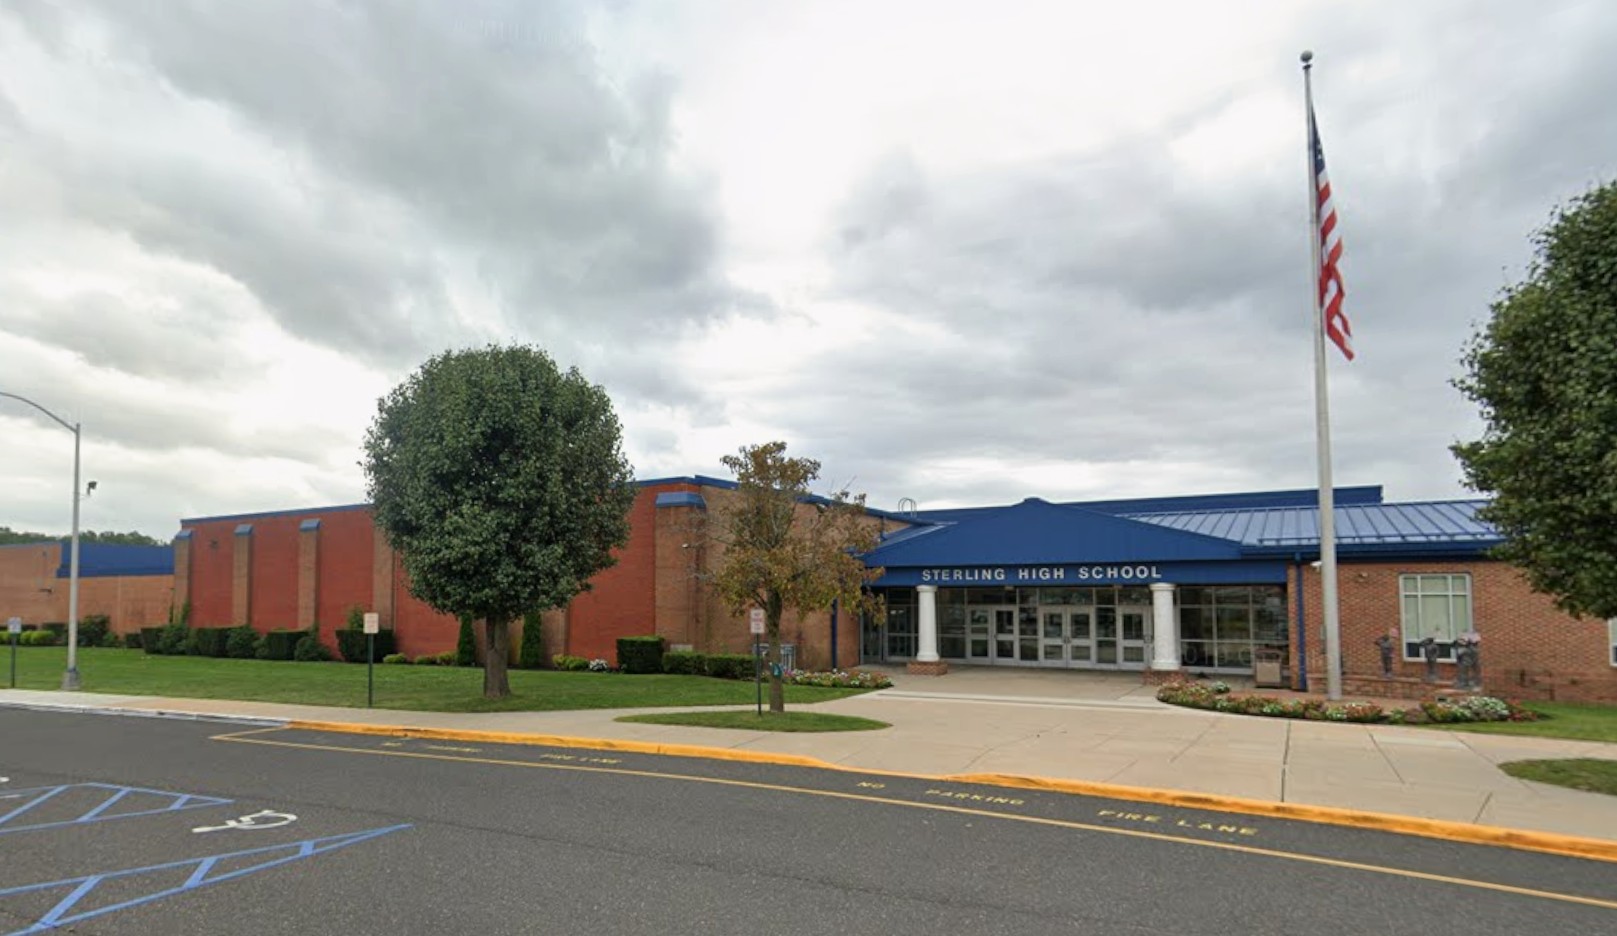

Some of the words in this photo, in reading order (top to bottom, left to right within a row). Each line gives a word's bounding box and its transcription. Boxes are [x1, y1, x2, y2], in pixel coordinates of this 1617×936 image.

[922, 568, 1005, 581] STERLING
[1018, 567, 1065, 580] HIGH
[1078, 565, 1162, 580] SCHOOL
[856, 780, 886, 789] NO
[923, 788, 1026, 806] PARKING
[1096, 809, 1162, 823] FIRE
[1176, 818, 1260, 837] LANE
